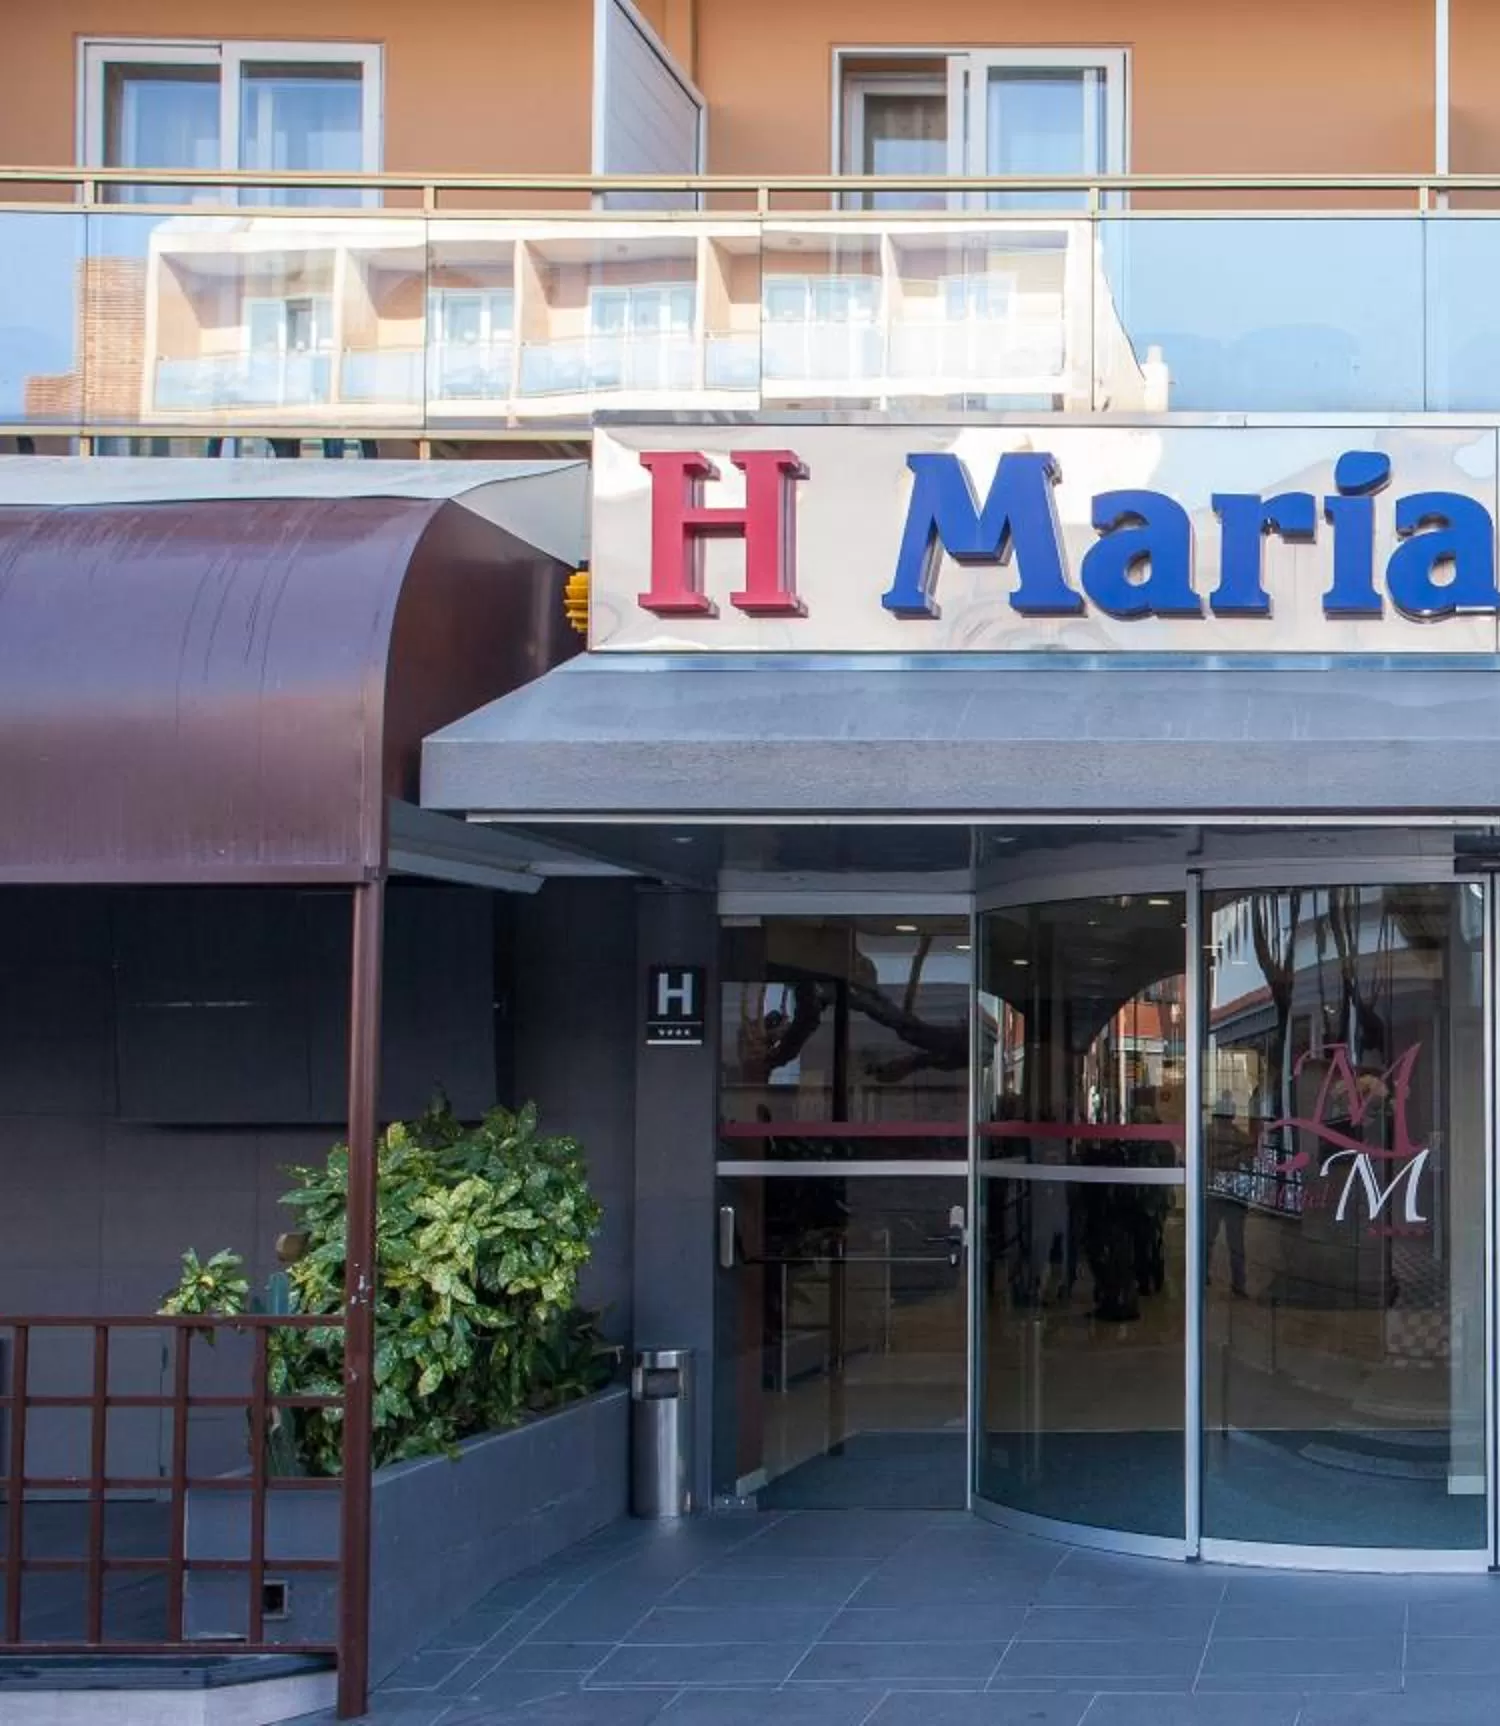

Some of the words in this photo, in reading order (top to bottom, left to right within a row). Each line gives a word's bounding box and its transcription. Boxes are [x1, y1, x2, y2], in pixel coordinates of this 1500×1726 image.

[637, 450, 811, 619] H
[657, 972, 694, 1015] H
[1320, 1147, 1432, 1224] M
